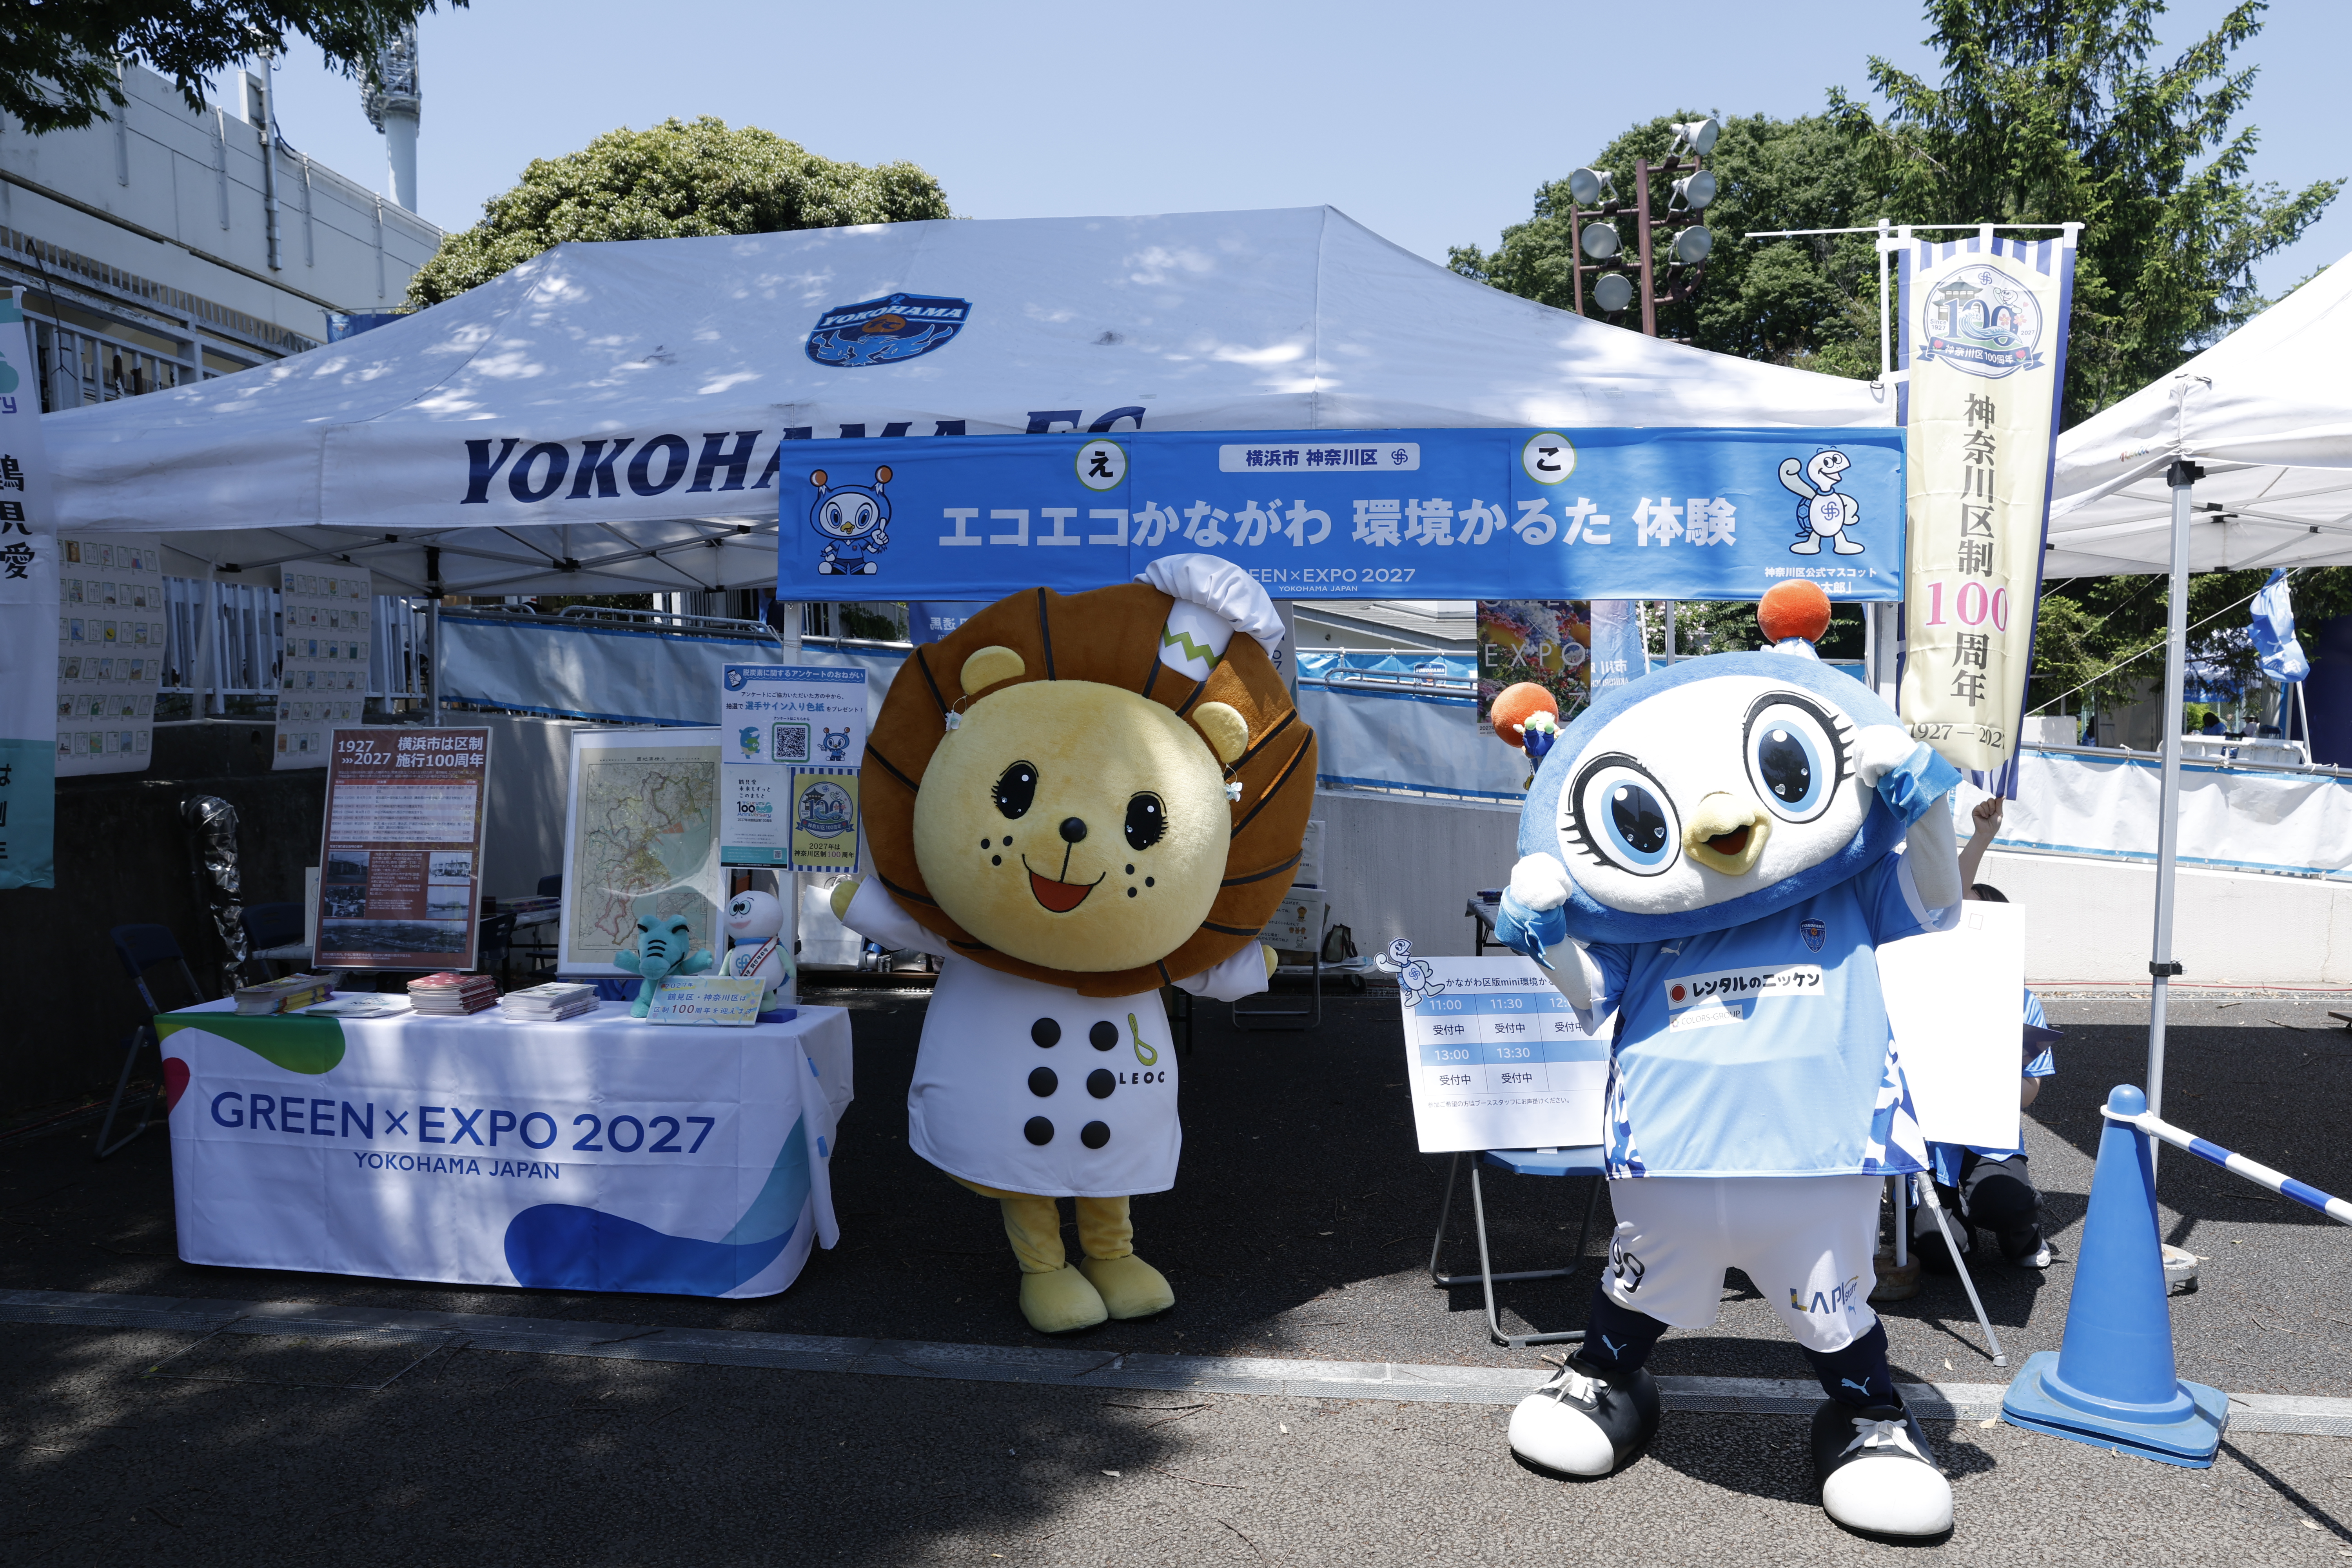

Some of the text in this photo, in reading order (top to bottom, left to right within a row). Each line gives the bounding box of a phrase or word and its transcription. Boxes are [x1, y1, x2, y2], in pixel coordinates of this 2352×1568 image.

[820, 305, 964, 326] YOKOHAMA
[1945, 345, 2014, 364] 神奈川区100周年
[1088, 451, 1114, 478] え
[1246, 448, 1378, 467] 横浜市 神奈川区
[1536, 446, 1561, 471] こ
[939, 497, 1737, 547] エコエコかながわ 環境かるた 体験
[1304, 568, 1357, 582] EXPO
[1362, 568, 1416, 582] 2027
[1765, 567, 1877, 578] 神奈川区公式マスコット
[1485, 642, 1586, 667] EXPO
[743, 669, 864, 679] 脱炭素に関するアンケートのおねがい
[741, 691, 844, 700] アンケートにご協力いただいた方の中から、
[745, 701, 825, 712] 選手サイン入り色紙
[1911, 723, 1953, 740] 1927
[338, 740, 374, 752] 1927
[397, 737, 483, 751] 横浜市は区制
[354, 753, 391, 764] 2027
[396, 753, 484, 768] 施行100周年
[750, 947, 768, 969] かながわ区
[1692, 973, 1820, 998] レンタルのニッケン
[667, 993, 746, 1002] 鶴見区・神奈川区は
[1429, 1000, 1462, 1010] 11:00
[1490, 998, 1523, 1009] 11:30
[653, 1004, 753, 1014] 区制100周年を迎えます
[1681, 1009, 1740, 1026] COLORS-GROUP
[1433, 1024, 1465, 1036] 受付中
[1494, 1022, 1525, 1034] 受付中
[1434, 1047, 1530, 1060] 13:00 13:30
[1120, 1071, 1165, 1084] LEOC
[1439, 1072, 1532, 1086] 受付中 受付中
[1428, 1098, 1570, 1109] 参加ご希望の方はブーススタッフにお声掛けください。
[210, 1091, 374, 1139] GREEN
[418, 1106, 558, 1151] EXPO
[572, 1113, 716, 1154] 2027
[354, 1152, 561, 1180] YOKOHAMA JAPAN
